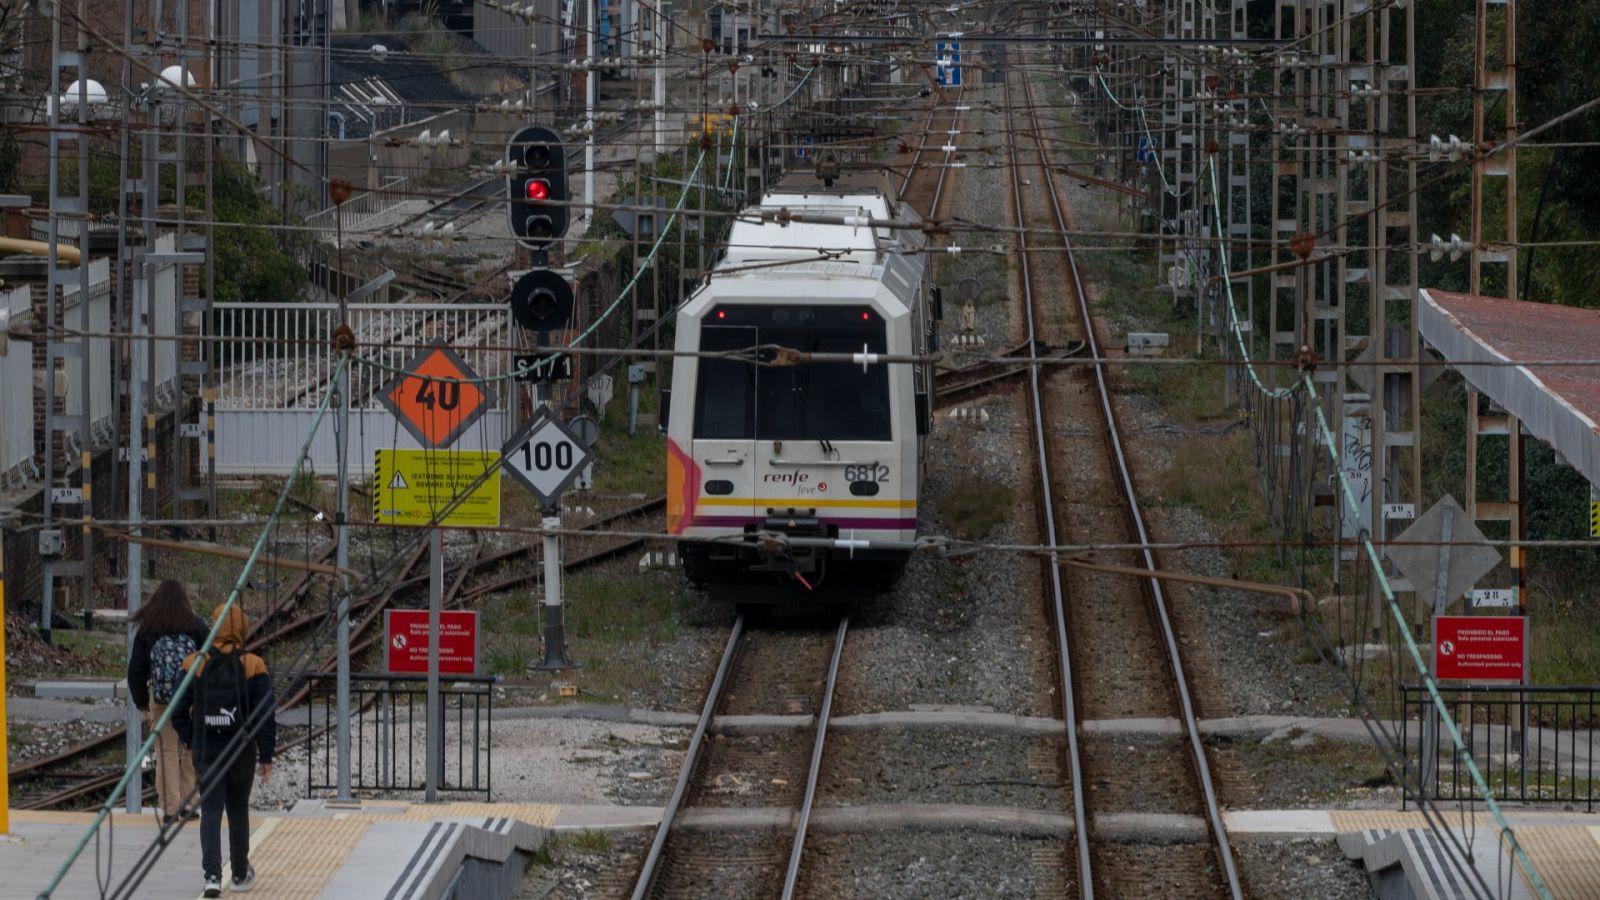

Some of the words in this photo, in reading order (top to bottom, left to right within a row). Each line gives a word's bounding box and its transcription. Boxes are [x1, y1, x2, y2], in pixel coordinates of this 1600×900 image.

[416, 376, 460, 411] 40
[520, 441, 573, 471] 100
[763, 469, 809, 487] renfe
[844, 465, 890, 482] 6812
[1485, 661, 1510, 669] personnel
[1510, 661, 1522, 669] only
[205, 714, 231, 726] PUMA
